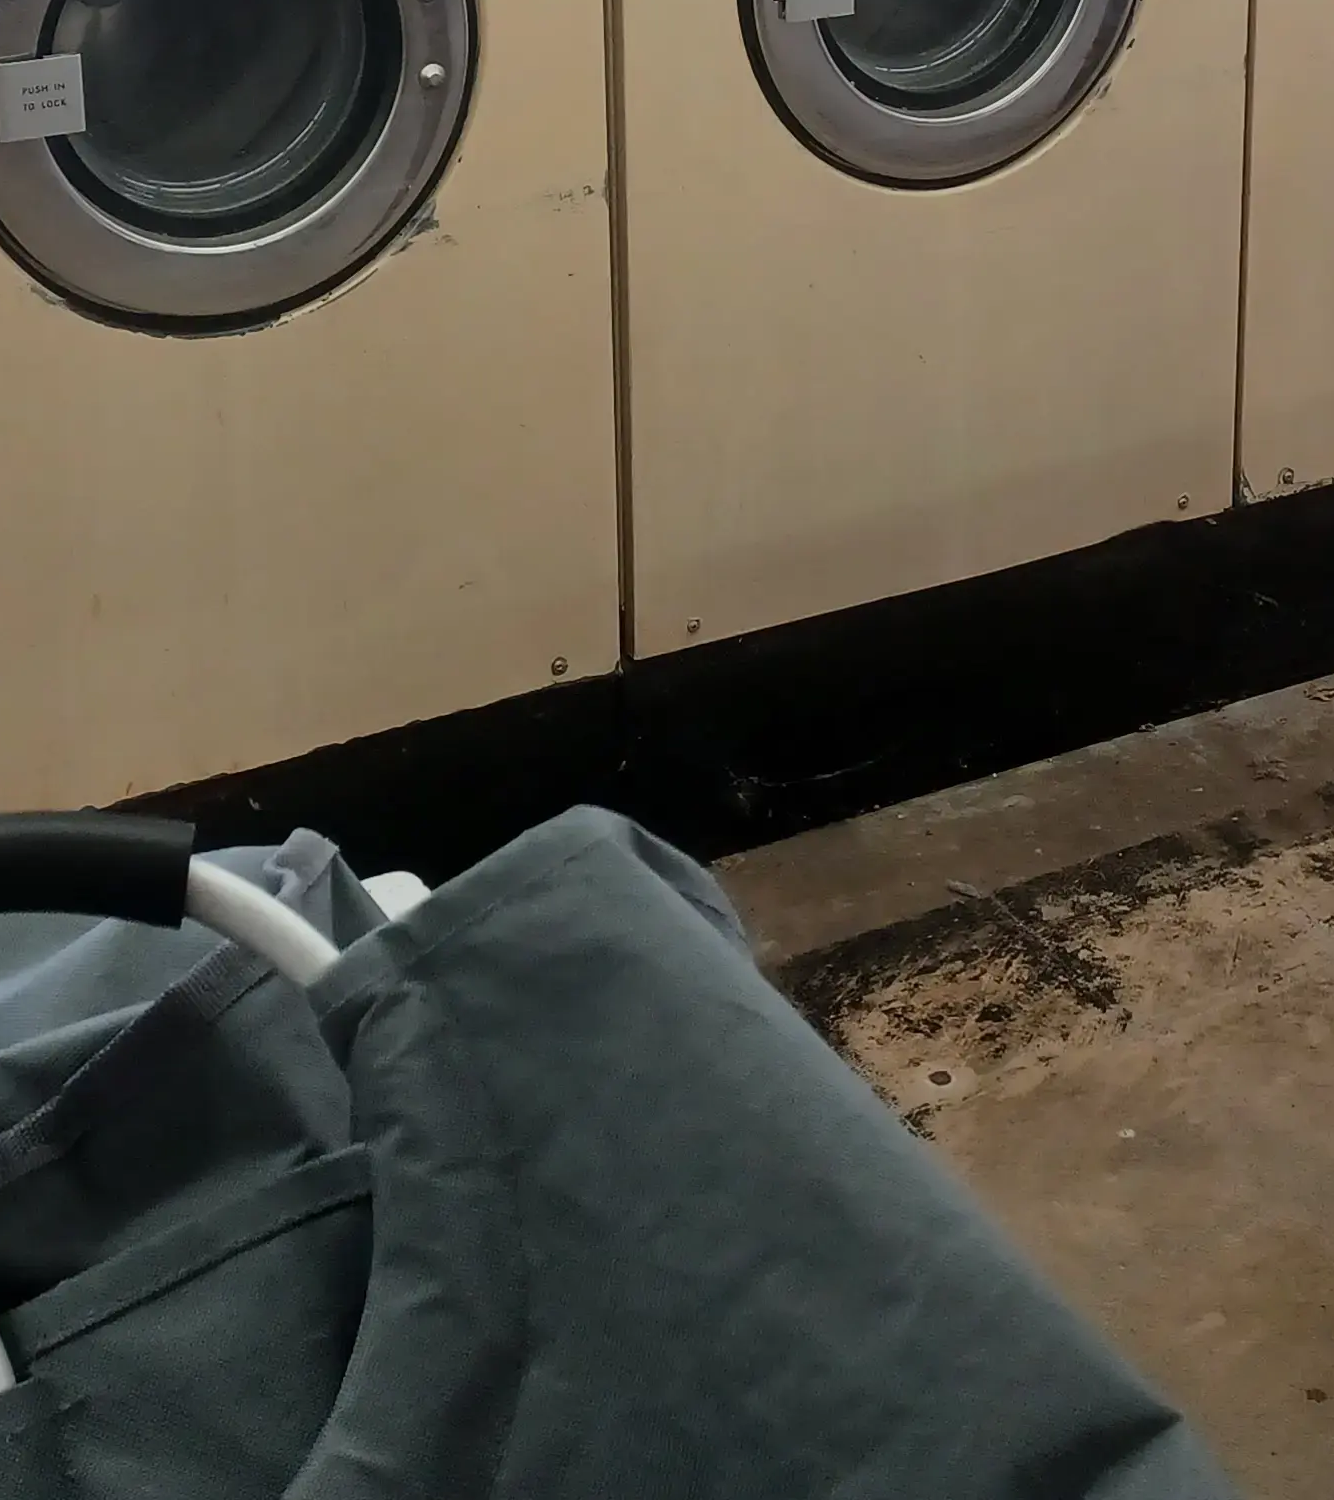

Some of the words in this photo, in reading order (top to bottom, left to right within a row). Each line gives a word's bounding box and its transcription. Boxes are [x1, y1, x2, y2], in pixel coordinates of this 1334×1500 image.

[21, 84, 49, 97] PUSH
[53, 82, 66, 94] IN
[22, 100, 36, 112] TO
[41, 98, 67, 110] LOCK
